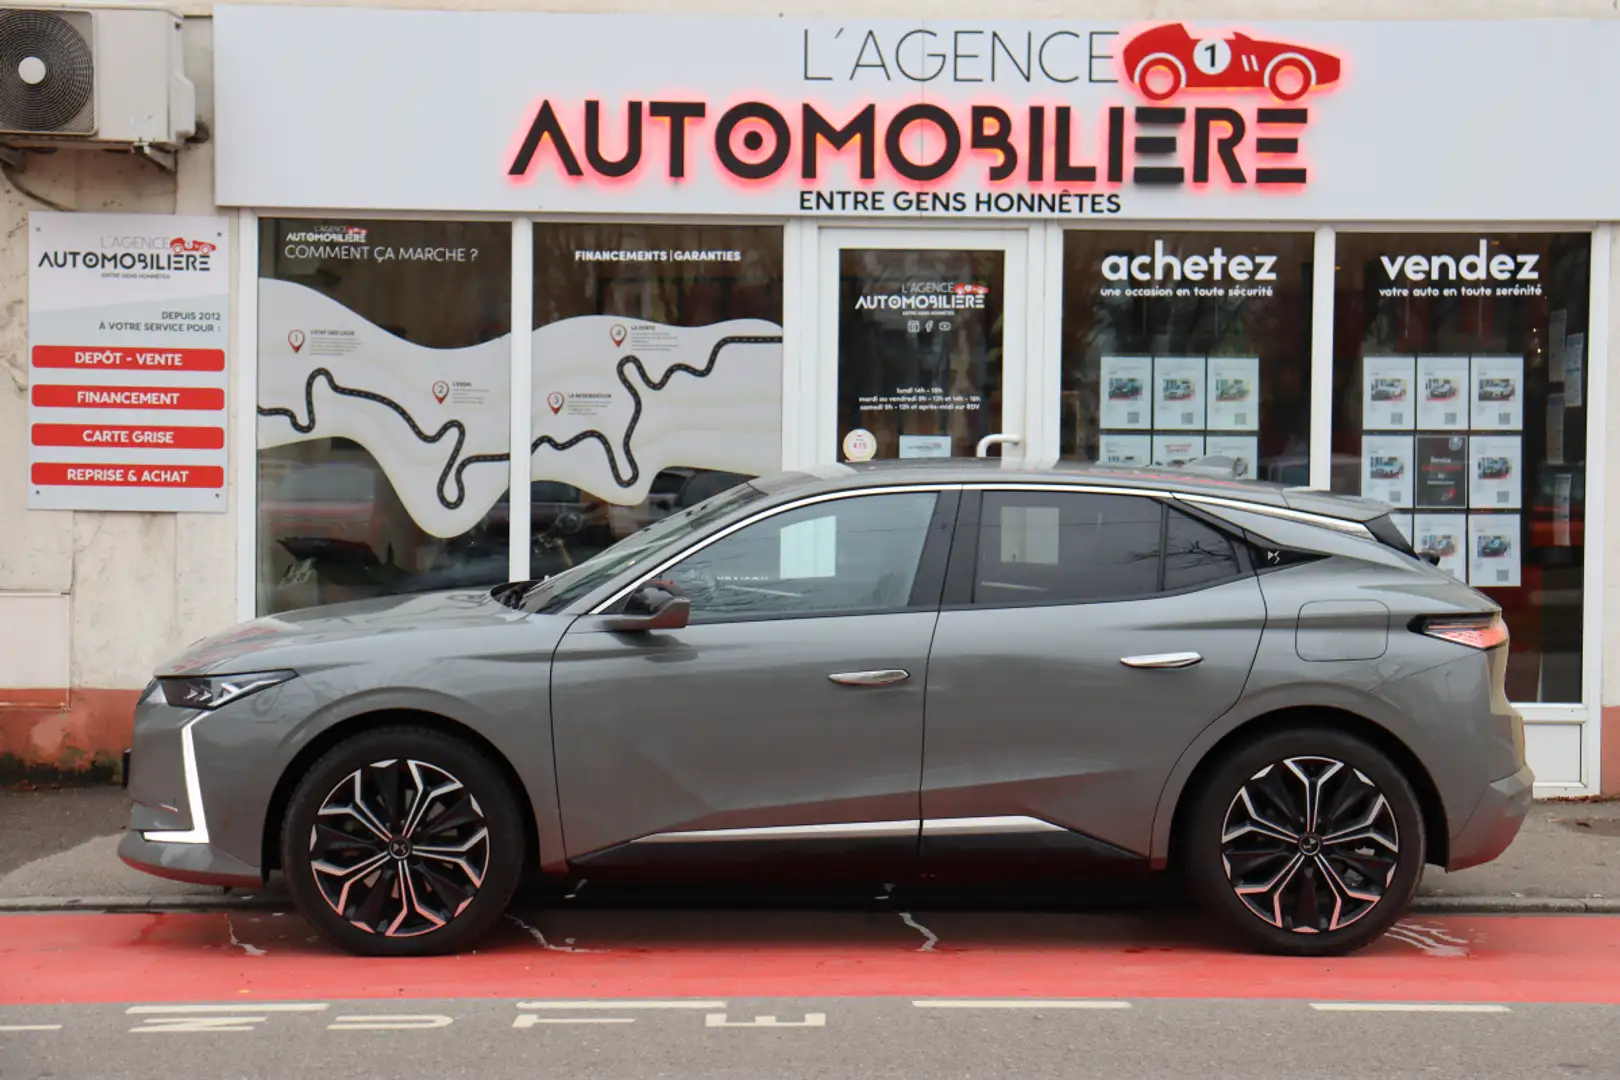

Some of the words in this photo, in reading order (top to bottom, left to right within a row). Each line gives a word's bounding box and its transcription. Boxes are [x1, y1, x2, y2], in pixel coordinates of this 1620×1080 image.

[1203, 43, 1219, 70] 1
[800, 190, 885, 211] ENTRE
[892, 192, 967, 213] GENS
[975, 192, 1121, 213] HONNÊTES
[284, 244, 369, 260] COMMENT
[373, 246, 395, 263] ÇA
[398, 247, 466, 262] MARCHE
[470, 248, 479, 262] ?
[574, 250, 667, 262] FINANCEMENTS
[673, 250, 741, 262] GARANTIES
[1101, 239, 1278, 281] achetez
[1380, 238, 1541, 281] vendez
[1100, 287, 1122, 297] une
[1125, 286, 1173, 297] occasion
[1176, 287, 1191, 297] en
[1194, 287, 1225, 297] toute
[1228, 285, 1274, 297] sécurité
[1379, 286, 1409, 297] votre
[1413, 287, 1439, 297] auto
[1443, 287, 1457, 297] en
[1461, 286, 1492, 297] toute
[1496, 284, 1543, 296] serénité
[161, 311, 195, 321] DEPUIS
[199, 312, 221, 321] 2012
[109, 322, 141, 332] VOTRE
[144, 323, 184, 332] SERVICE
[187, 324, 215, 333] POUR
[74, 350, 122, 365] DEPÔT
[136, 353, 183, 367] VENTE
[76, 390, 180, 406] FINANCEMENT
[82, 430, 129, 444] CARTE
[132, 430, 174, 444] GRISE
[67, 468, 125, 483] REPRISE
[128, 470, 136, 483] &
[142, 471, 189, 484] ACHAT
